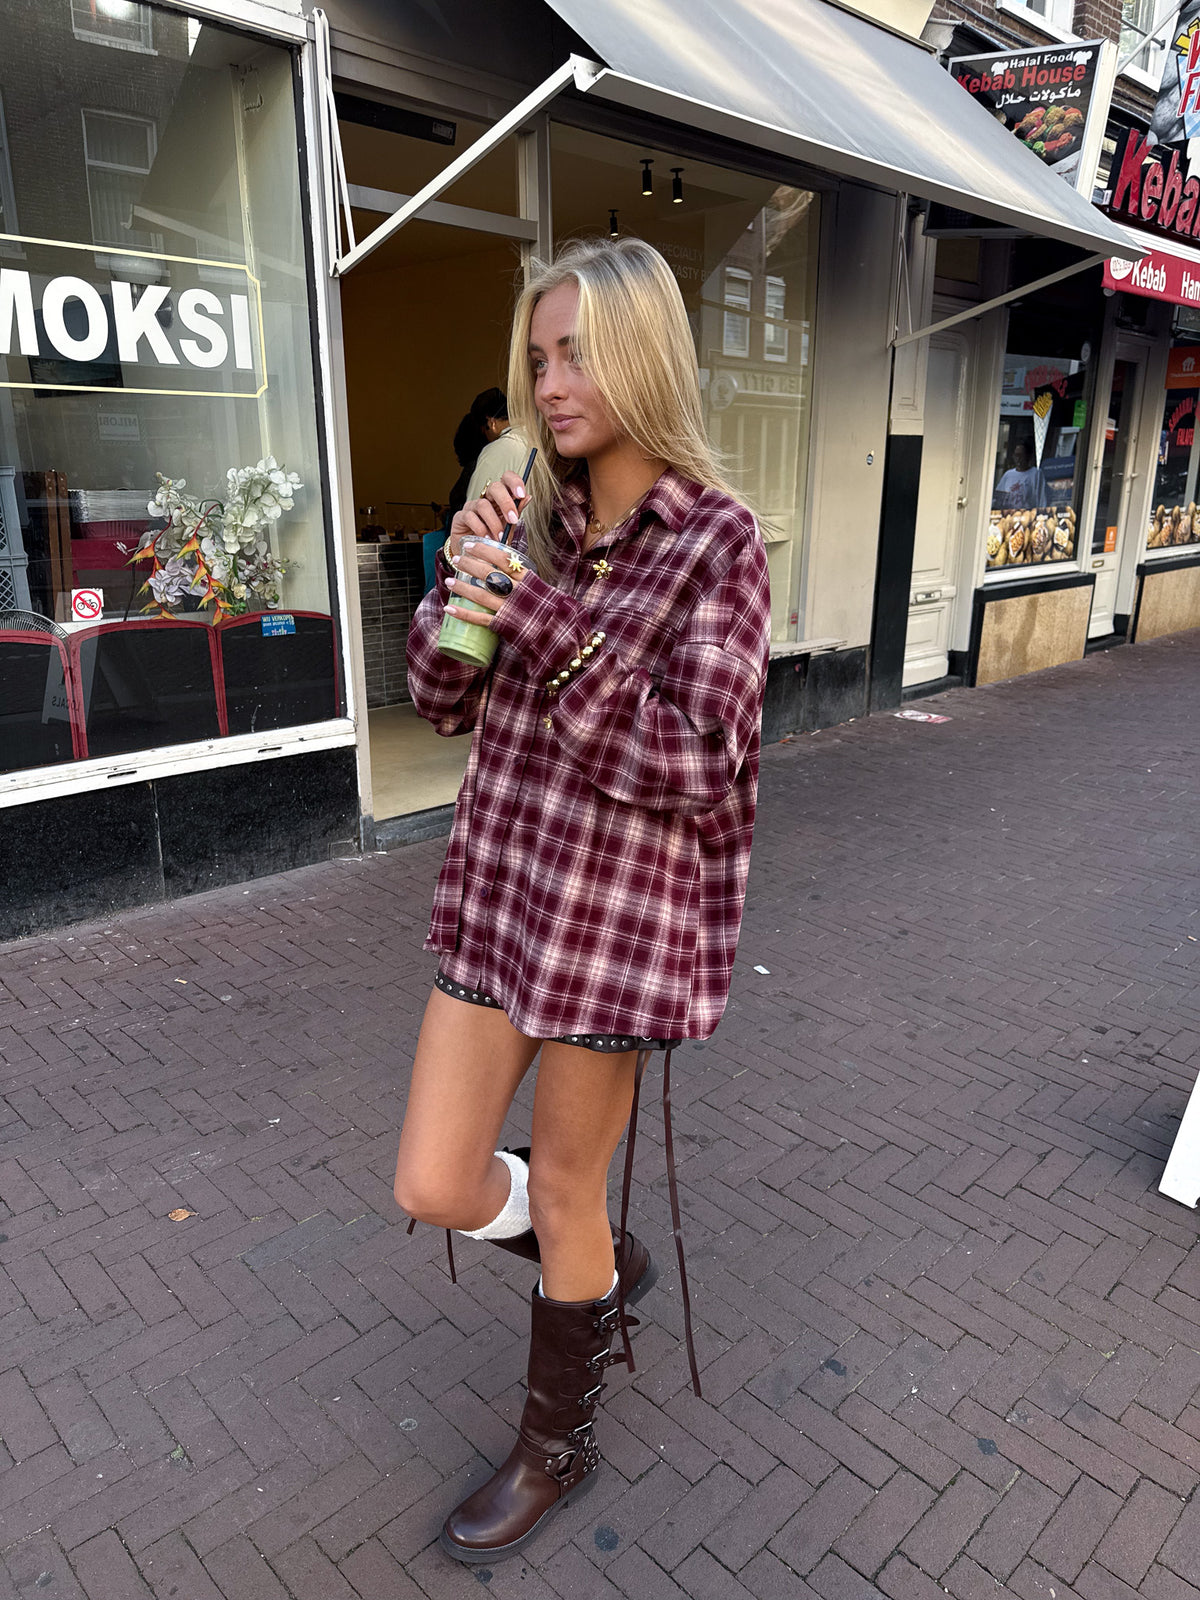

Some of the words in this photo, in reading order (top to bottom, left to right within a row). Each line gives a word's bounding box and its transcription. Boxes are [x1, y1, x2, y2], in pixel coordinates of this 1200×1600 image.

[1009, 55, 1041, 69] Halal
[1043, 51, 1074, 64] Food
[957, 69, 1016, 94] Kebab
[1021, 64, 1086, 87] House
[995, 92, 1026, 108] حلال
[1029, 80, 1081, 102] مأكولات
[1131, 260, 1167, 293] Kebab
